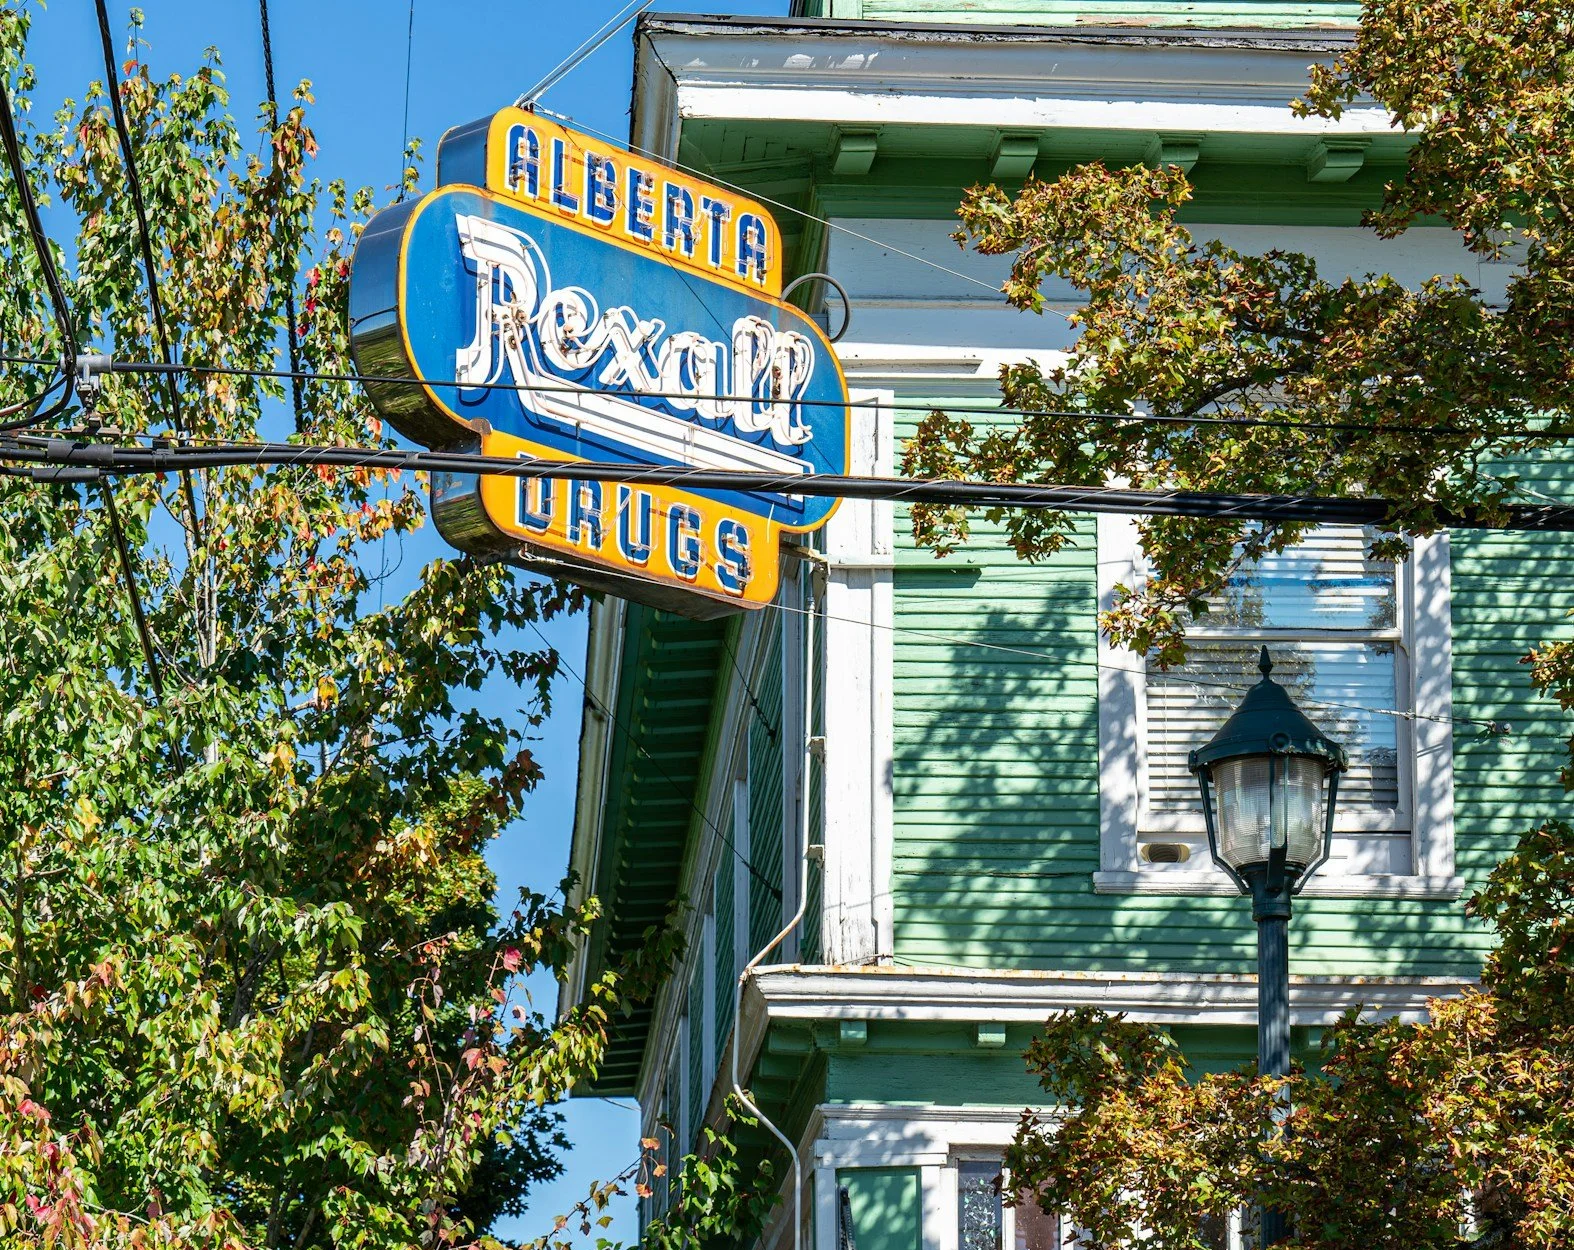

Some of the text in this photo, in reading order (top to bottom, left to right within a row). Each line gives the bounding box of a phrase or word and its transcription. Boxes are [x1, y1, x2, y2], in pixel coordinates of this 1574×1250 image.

[505, 123, 767, 286] ALBERTA
[455, 213, 816, 498] Rexall
[514, 451, 753, 596] DRUGS
